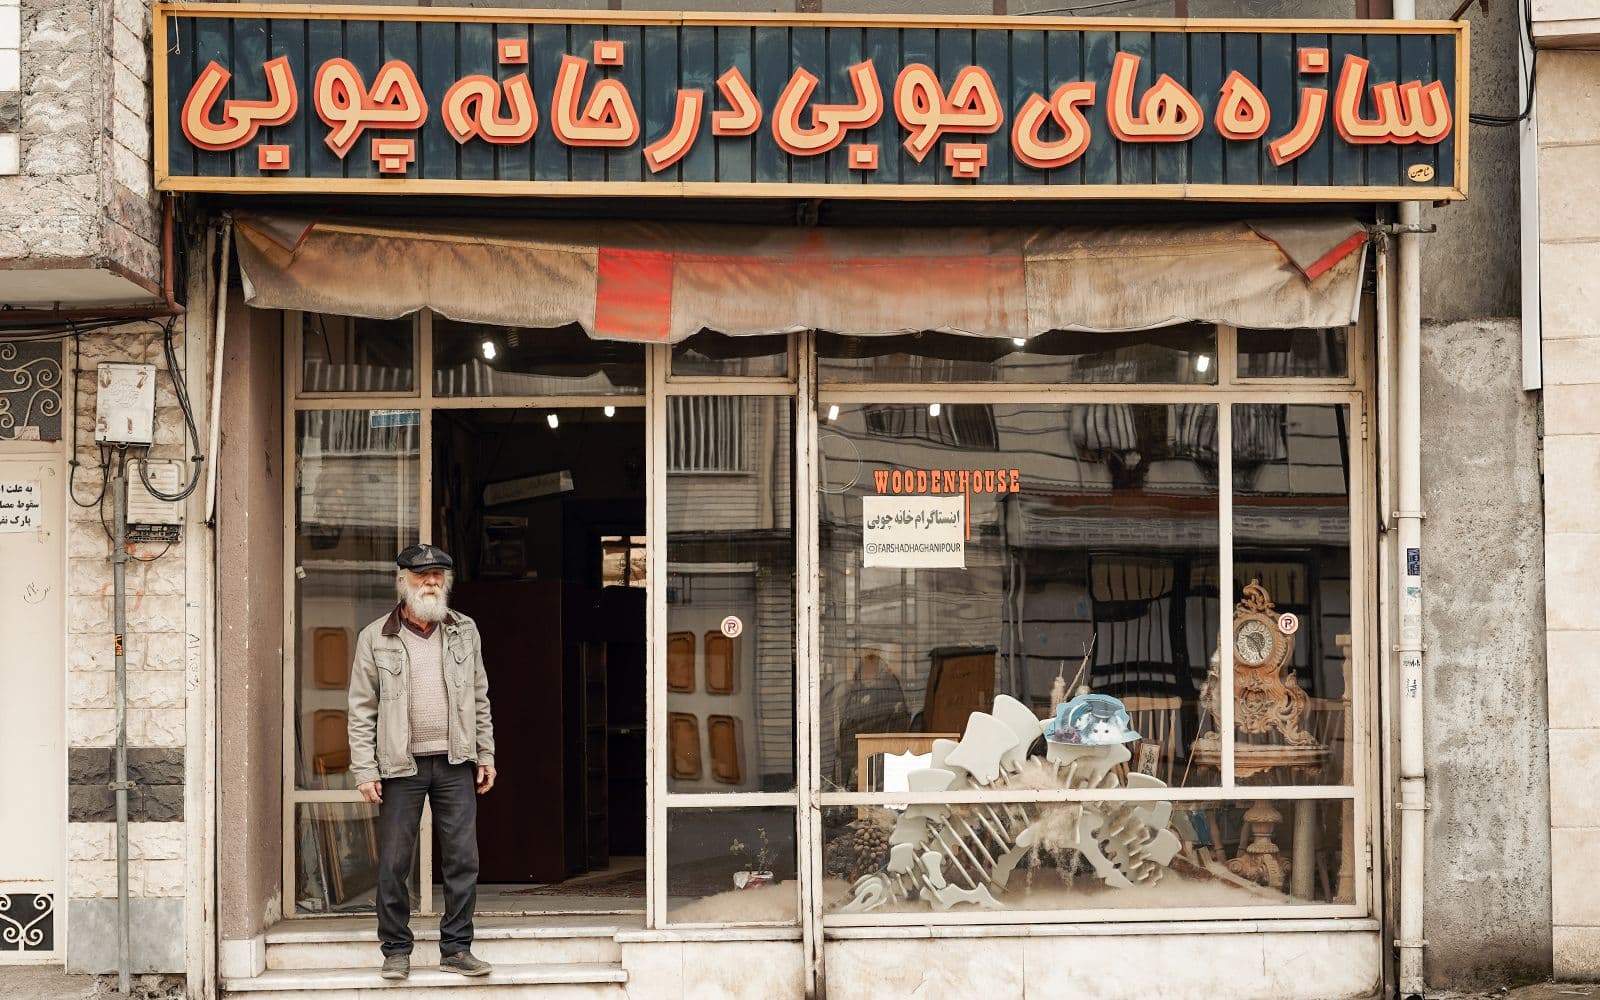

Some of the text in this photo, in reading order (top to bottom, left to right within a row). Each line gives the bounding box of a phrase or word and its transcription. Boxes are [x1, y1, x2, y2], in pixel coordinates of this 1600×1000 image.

[181, 55, 429, 174] چوبی
[441, 38, 641, 147] خانه
[643, 66, 763, 173] در
[772, 59, 1004, 178] چوبی
[1011, 52, 1205, 168] های
[6, 484, 23, 493] علت
[16, 499, 40, 511] سقوط
[867, 509, 960, 530] اینستاگرام خانه چوبی
[10, 515, 31, 527] پارک
[878, 542, 961, 553] FARSHADHAGHANIPOUR
